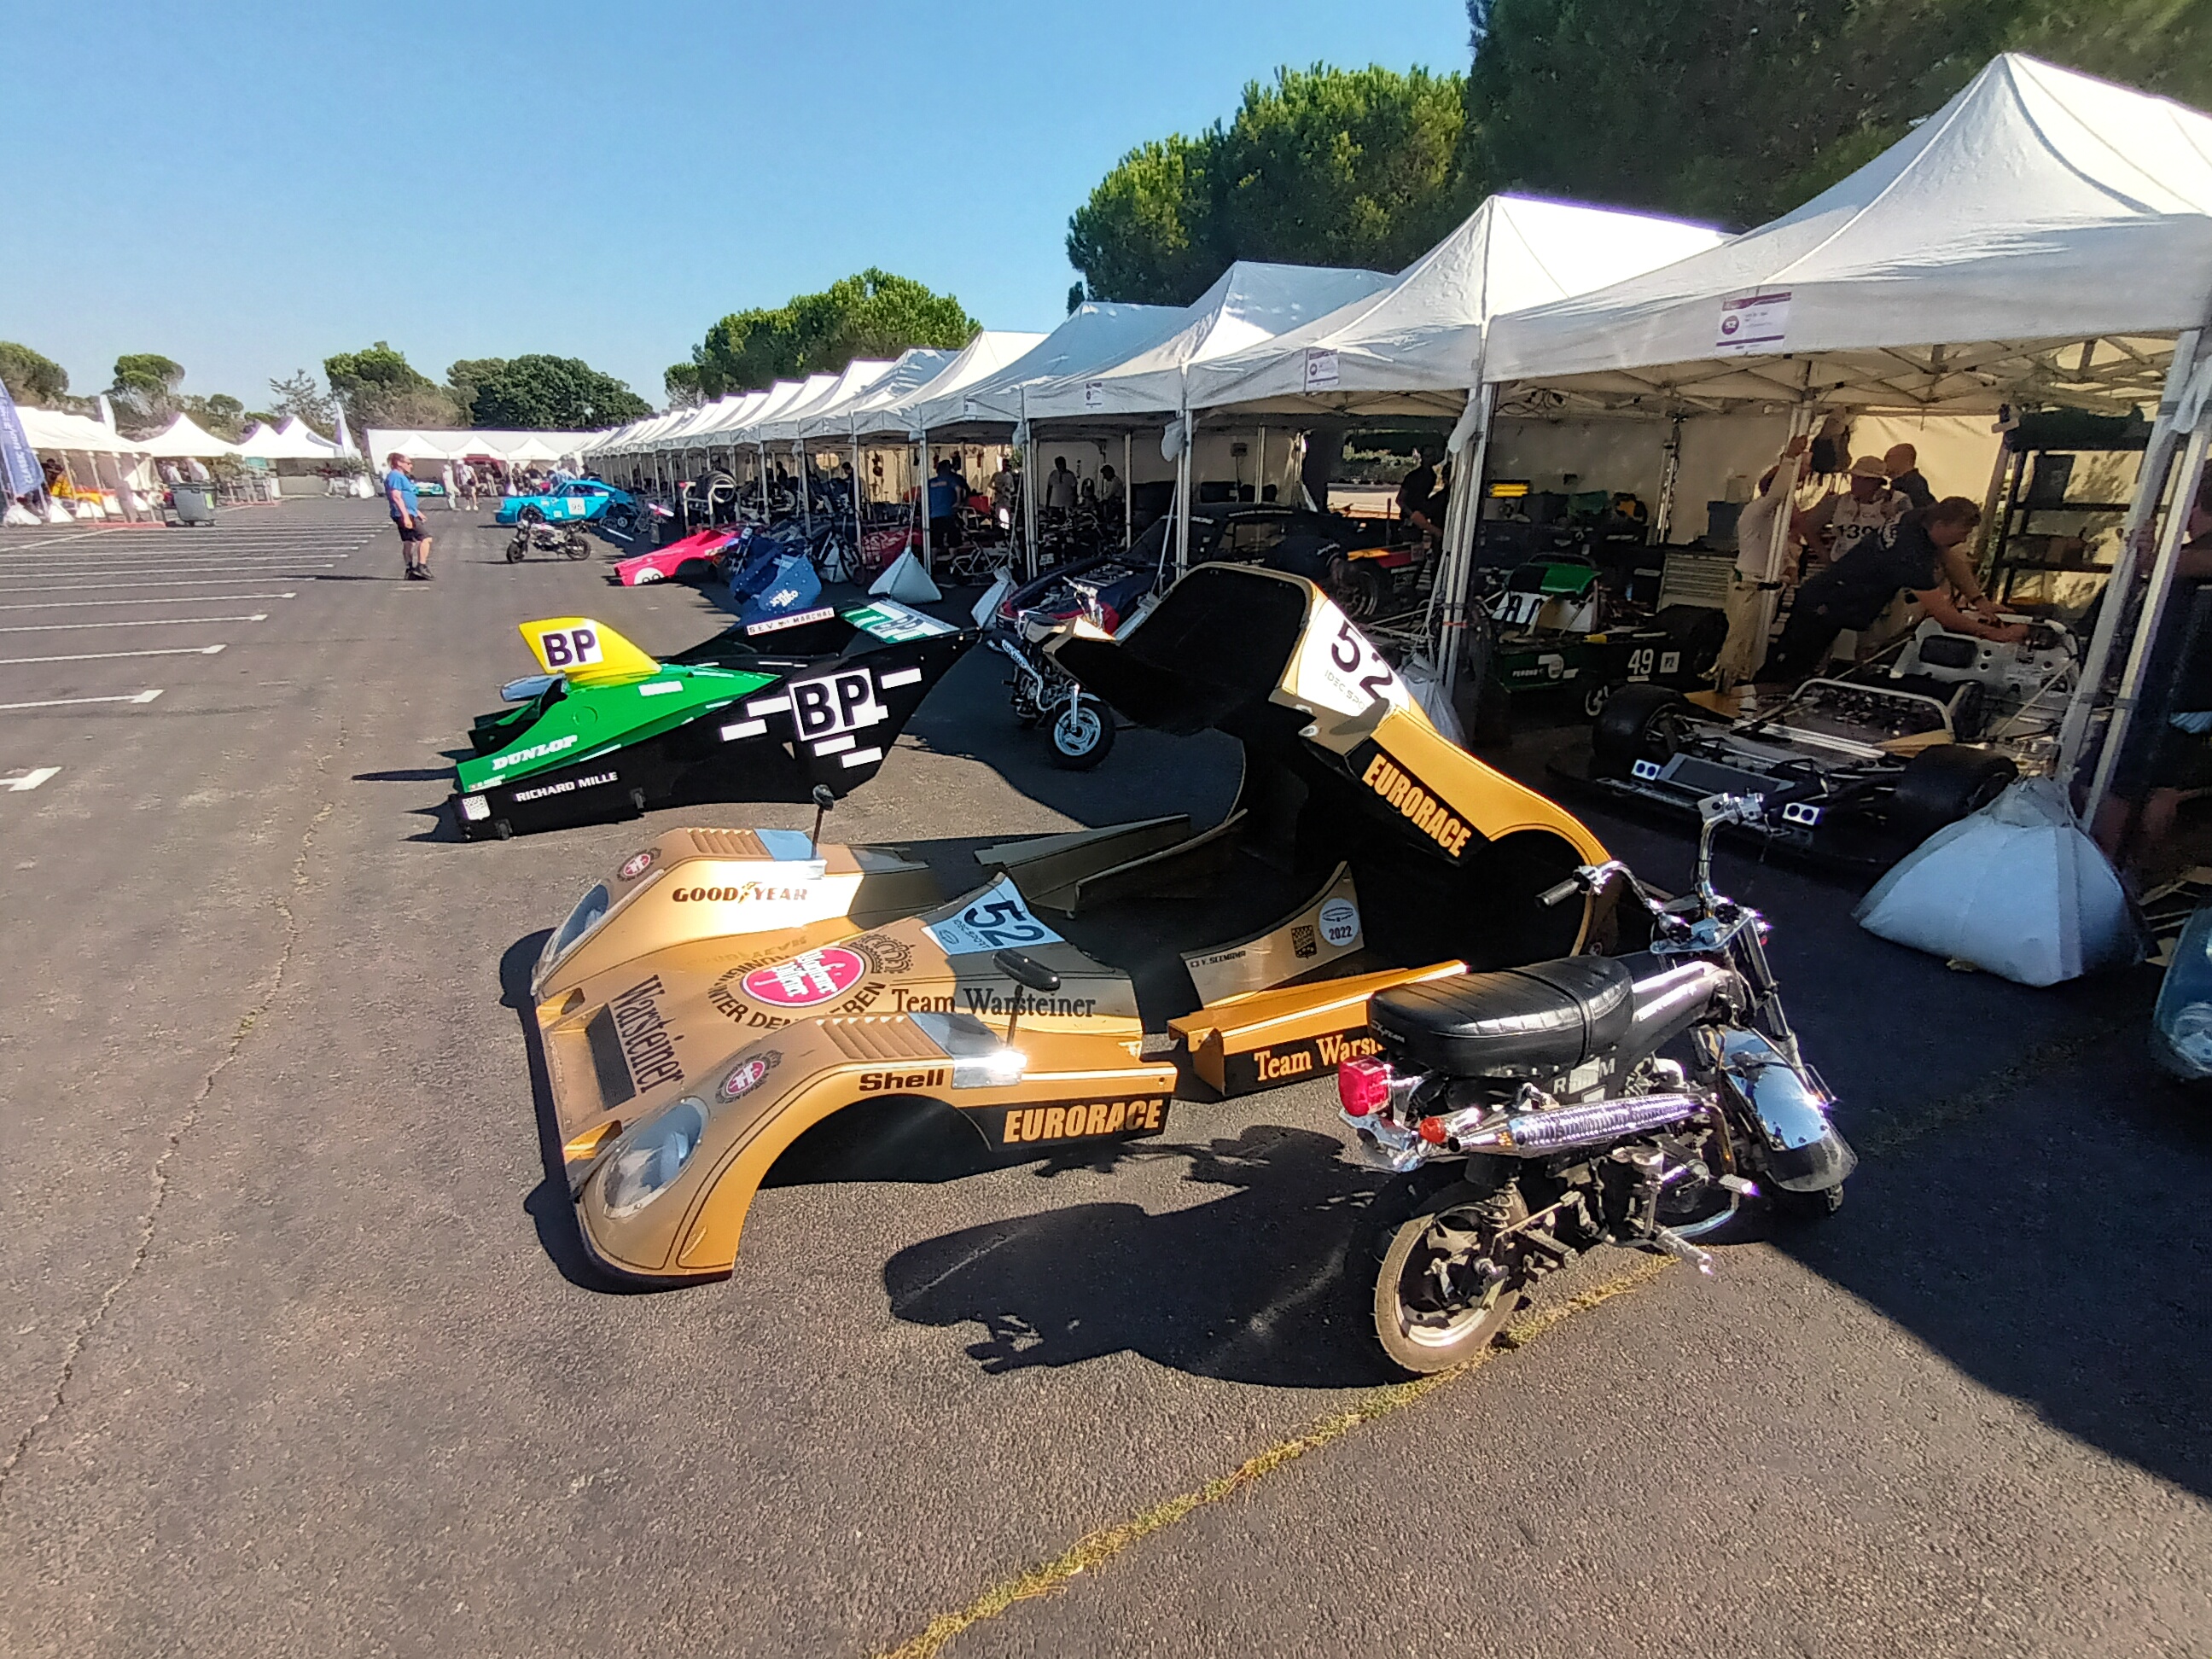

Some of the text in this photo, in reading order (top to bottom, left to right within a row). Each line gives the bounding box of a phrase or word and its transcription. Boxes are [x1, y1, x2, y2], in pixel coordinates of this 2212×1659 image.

[748, 610, 833, 633] SEV MARCHAL
[542, 629, 596, 667] BP
[1331, 619, 1394, 700] 52
[1627, 649, 1654, 675] 49
[794, 674, 870, 736] BP
[492, 735, 578, 770] DUNLOP
[515, 781, 575, 802] RICHARD
[577, 771, 619, 789] MILLE
[1362, 753, 1472, 858] EURORACE
[963, 899, 1045, 946] 52
[1329, 925, 1353, 940] 2022
[892, 987, 1096, 1018] Team Warsteiner
[611, 975, 684, 1093] Warsteiner
[859, 1069, 944, 1091] Shell
[1254, 1050, 1313, 1081] Team
[1003, 1099, 1163, 1144] EURORACE
